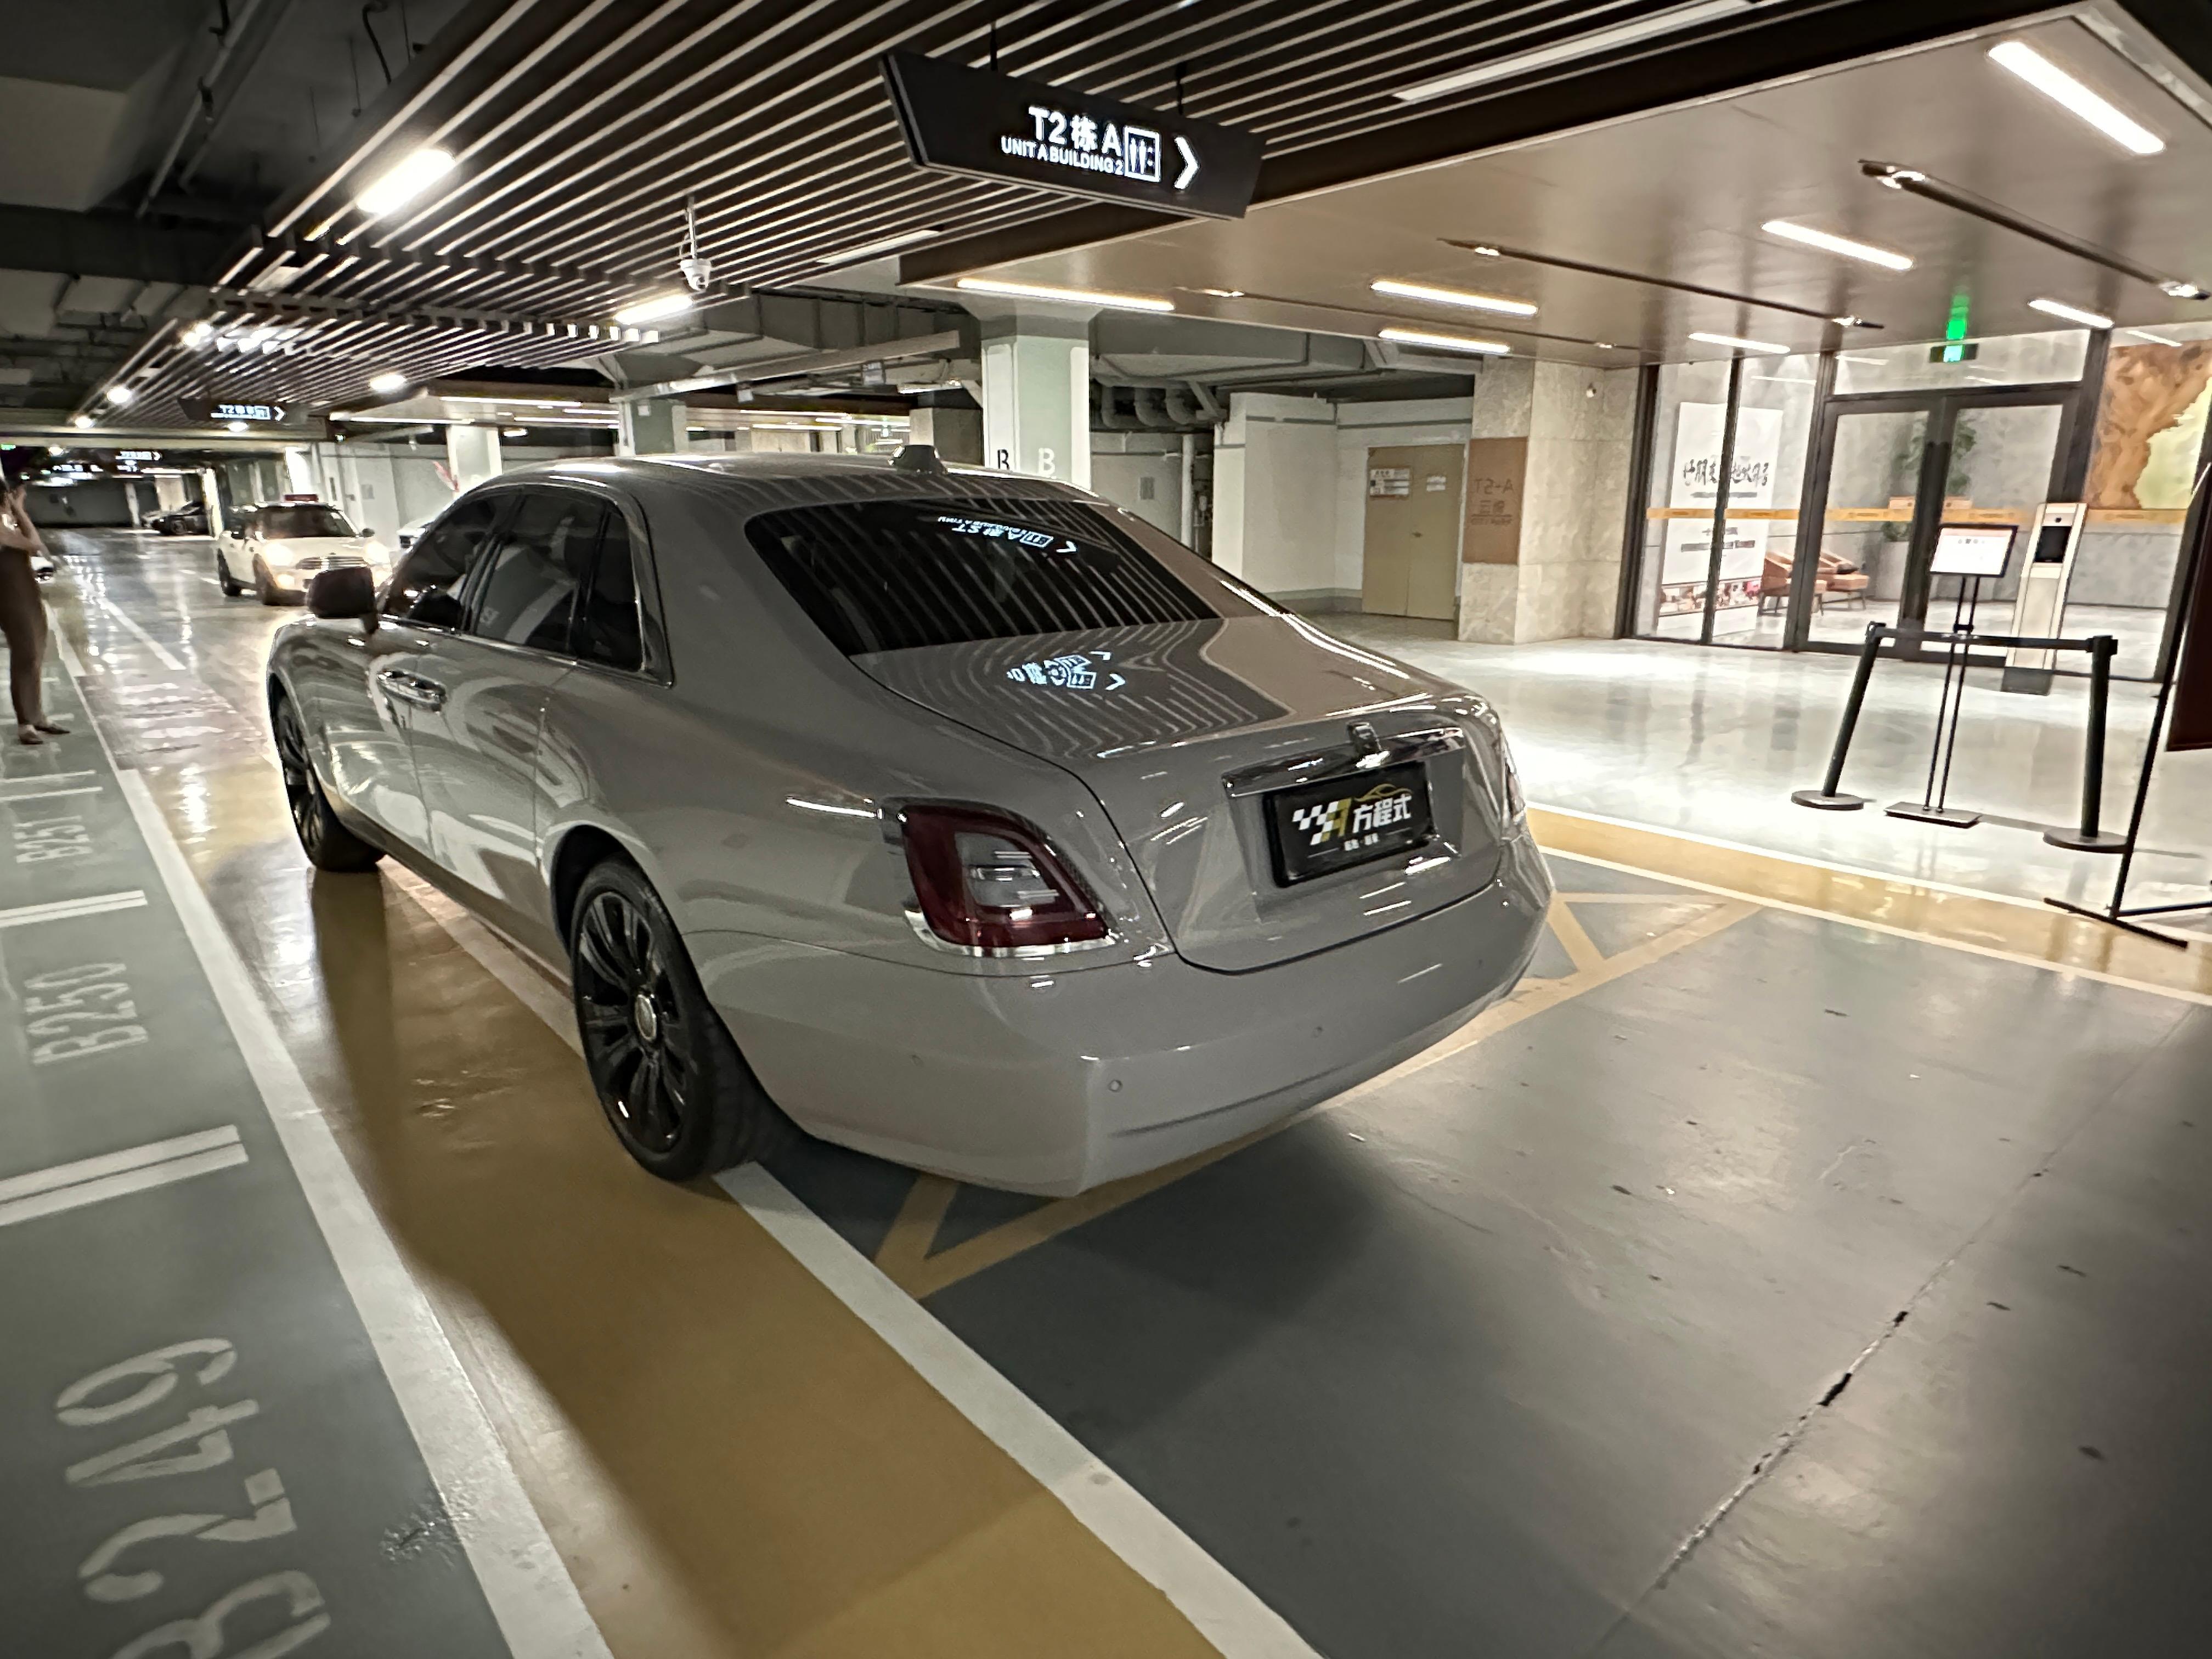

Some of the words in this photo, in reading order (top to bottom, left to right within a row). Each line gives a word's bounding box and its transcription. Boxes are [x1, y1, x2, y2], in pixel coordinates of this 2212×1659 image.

[1000, 135, 1037, 159] UNIT
[1036, 143, 1049, 162] A
[1048, 145, 1115, 173] BUILDING
[1114, 159, 1125, 176] 2
[1037, 447, 1056, 476] B
[1352, 793, 1413, 834] 方程式
[24, 962, 149, 1066] B250
[55, 1337, 331, 1659] B249
